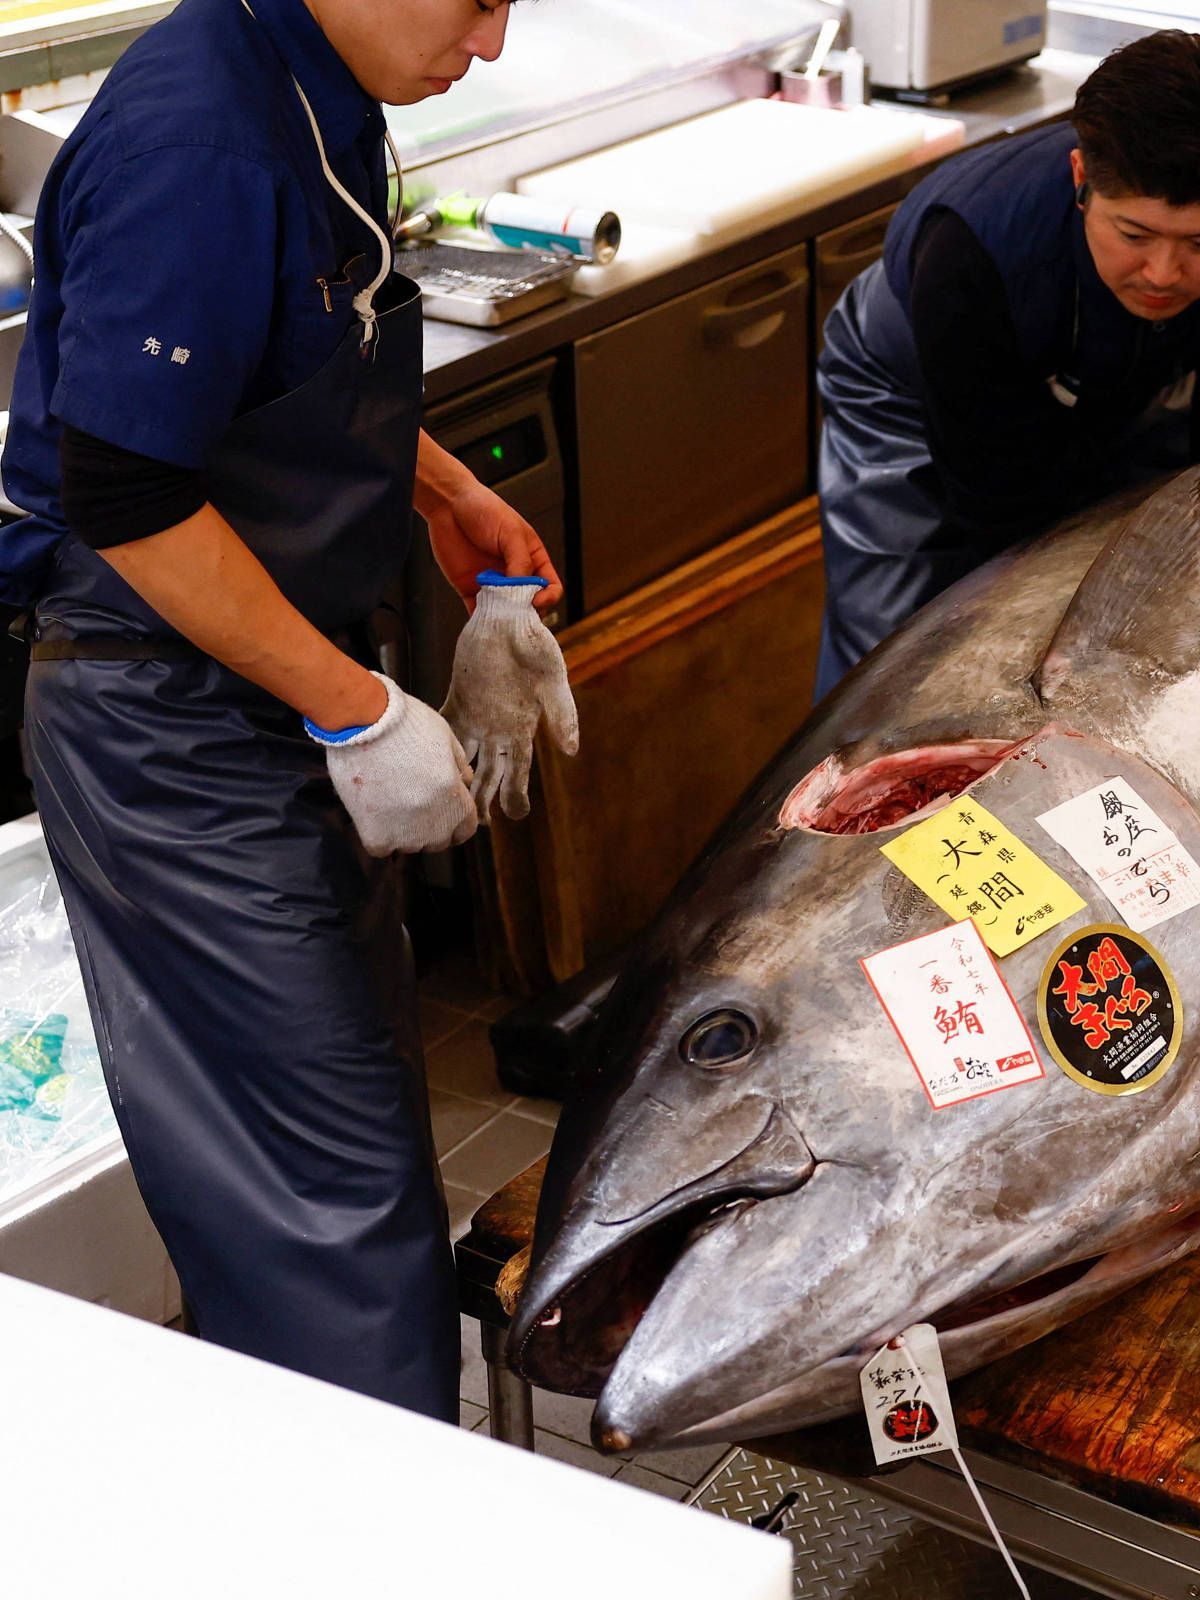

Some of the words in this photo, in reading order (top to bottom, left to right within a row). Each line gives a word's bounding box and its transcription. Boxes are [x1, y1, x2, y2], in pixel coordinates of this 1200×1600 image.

[957, 811, 1017, 864] 青森県
[1099, 789, 1158, 847] 銀座
[943, 837, 1025, 911] 大間
[1103, 826, 1171, 906] おのでら
[917, 958, 985, 1045] 一番鮪
[950, 936, 989, 997] 令和七年
[1052, 936, 1132, 1013] 大間
[1070, 974, 1154, 1051] まぐろ
